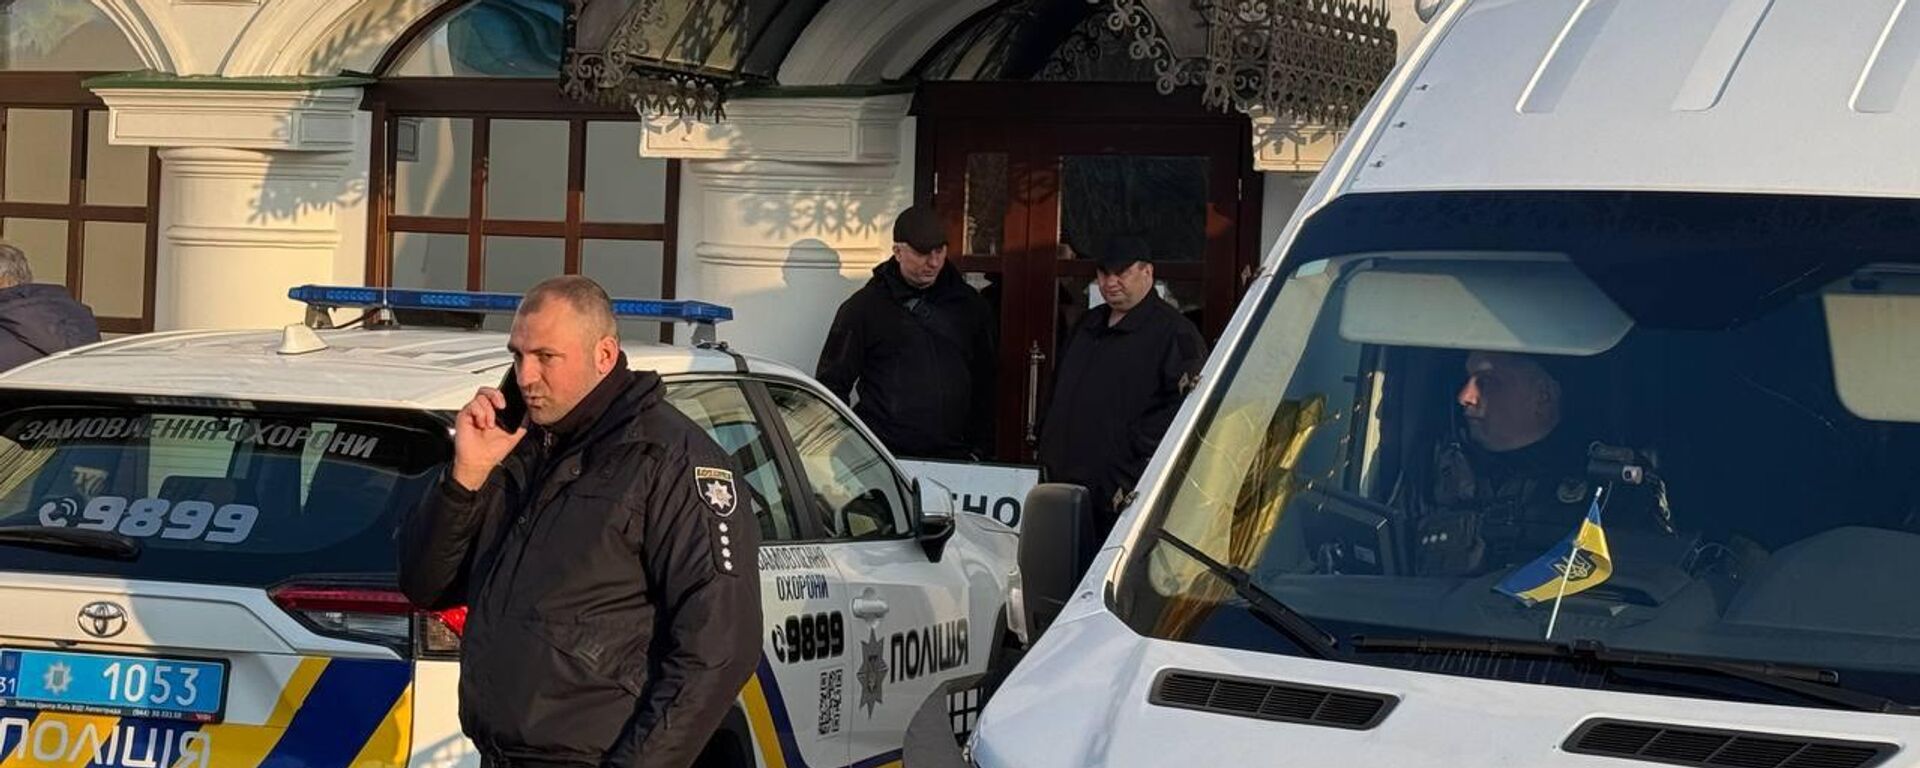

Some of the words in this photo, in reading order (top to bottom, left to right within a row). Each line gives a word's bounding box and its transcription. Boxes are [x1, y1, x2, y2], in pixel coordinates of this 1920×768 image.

[19, 416, 221, 442] ЗАМОВЛЕННЯ
[224, 420, 379, 459] ОХОРОНИ
[76, 496, 259, 543] 9899
[952, 493, 1021, 528] НО
[776, 574, 829, 601] ОХОРОНИ
[785, 611, 844, 664] 9899
[890, 618, 969, 683] ПОЛІЦІЯ
[103, 662, 199, 706] 1053
[0, 717, 211, 768] ПОЛІЦІЯ
